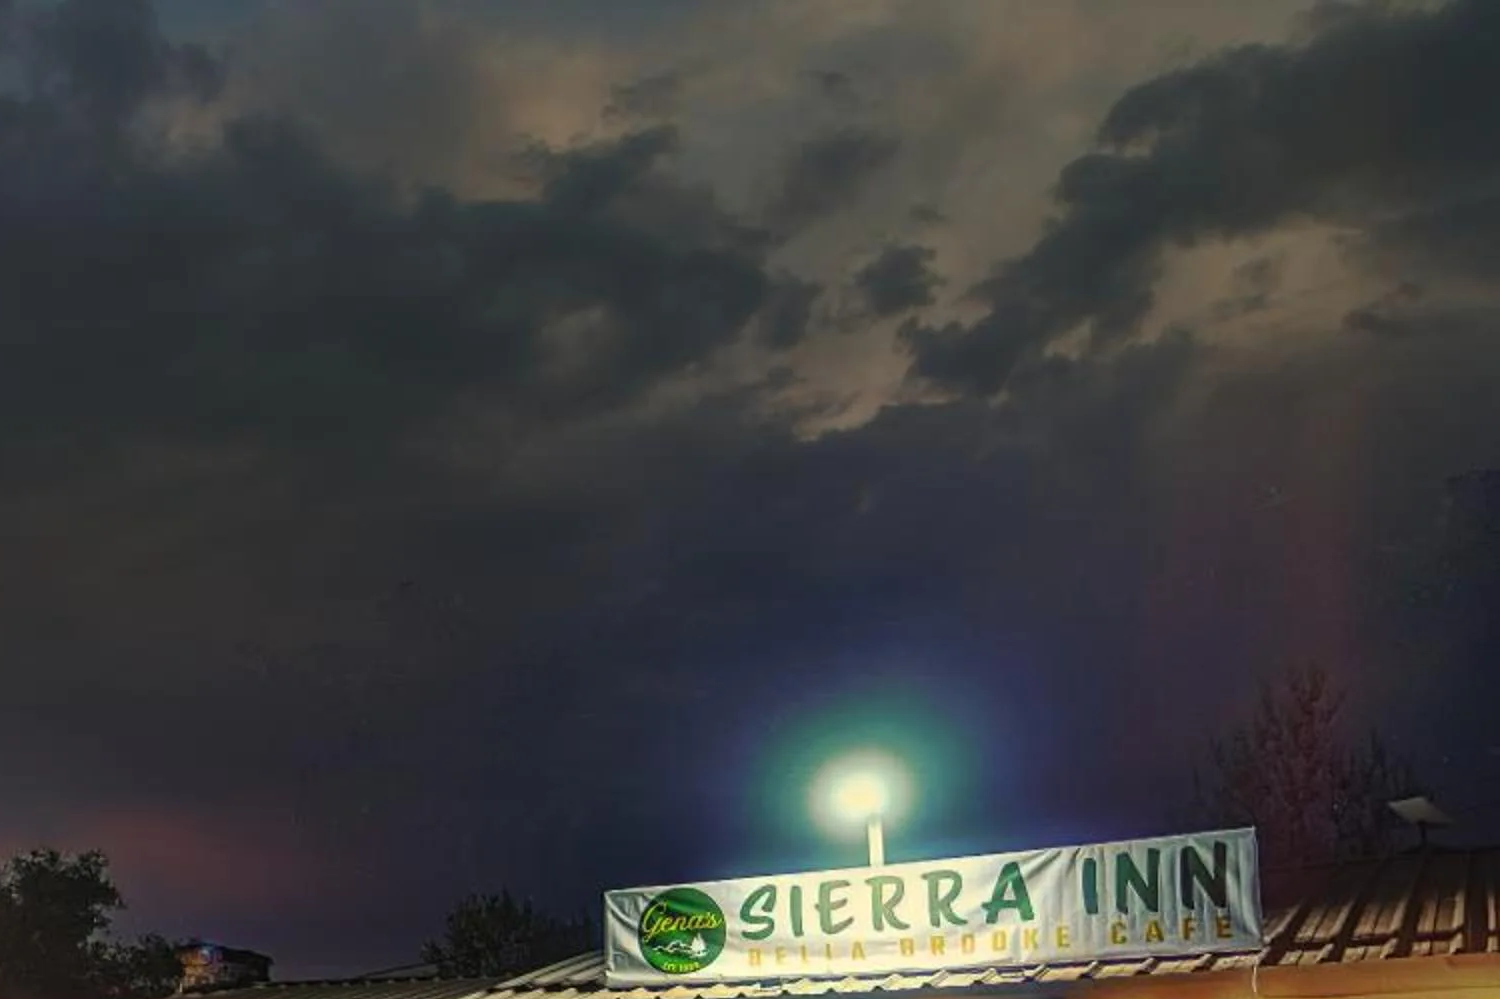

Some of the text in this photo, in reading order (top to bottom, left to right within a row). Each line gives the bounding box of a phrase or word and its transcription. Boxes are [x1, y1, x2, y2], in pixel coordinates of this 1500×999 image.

[740, 841, 1229, 942] SIERRA INN
[748, 914, 1234, 967] BELLA BROOKE CAFE
